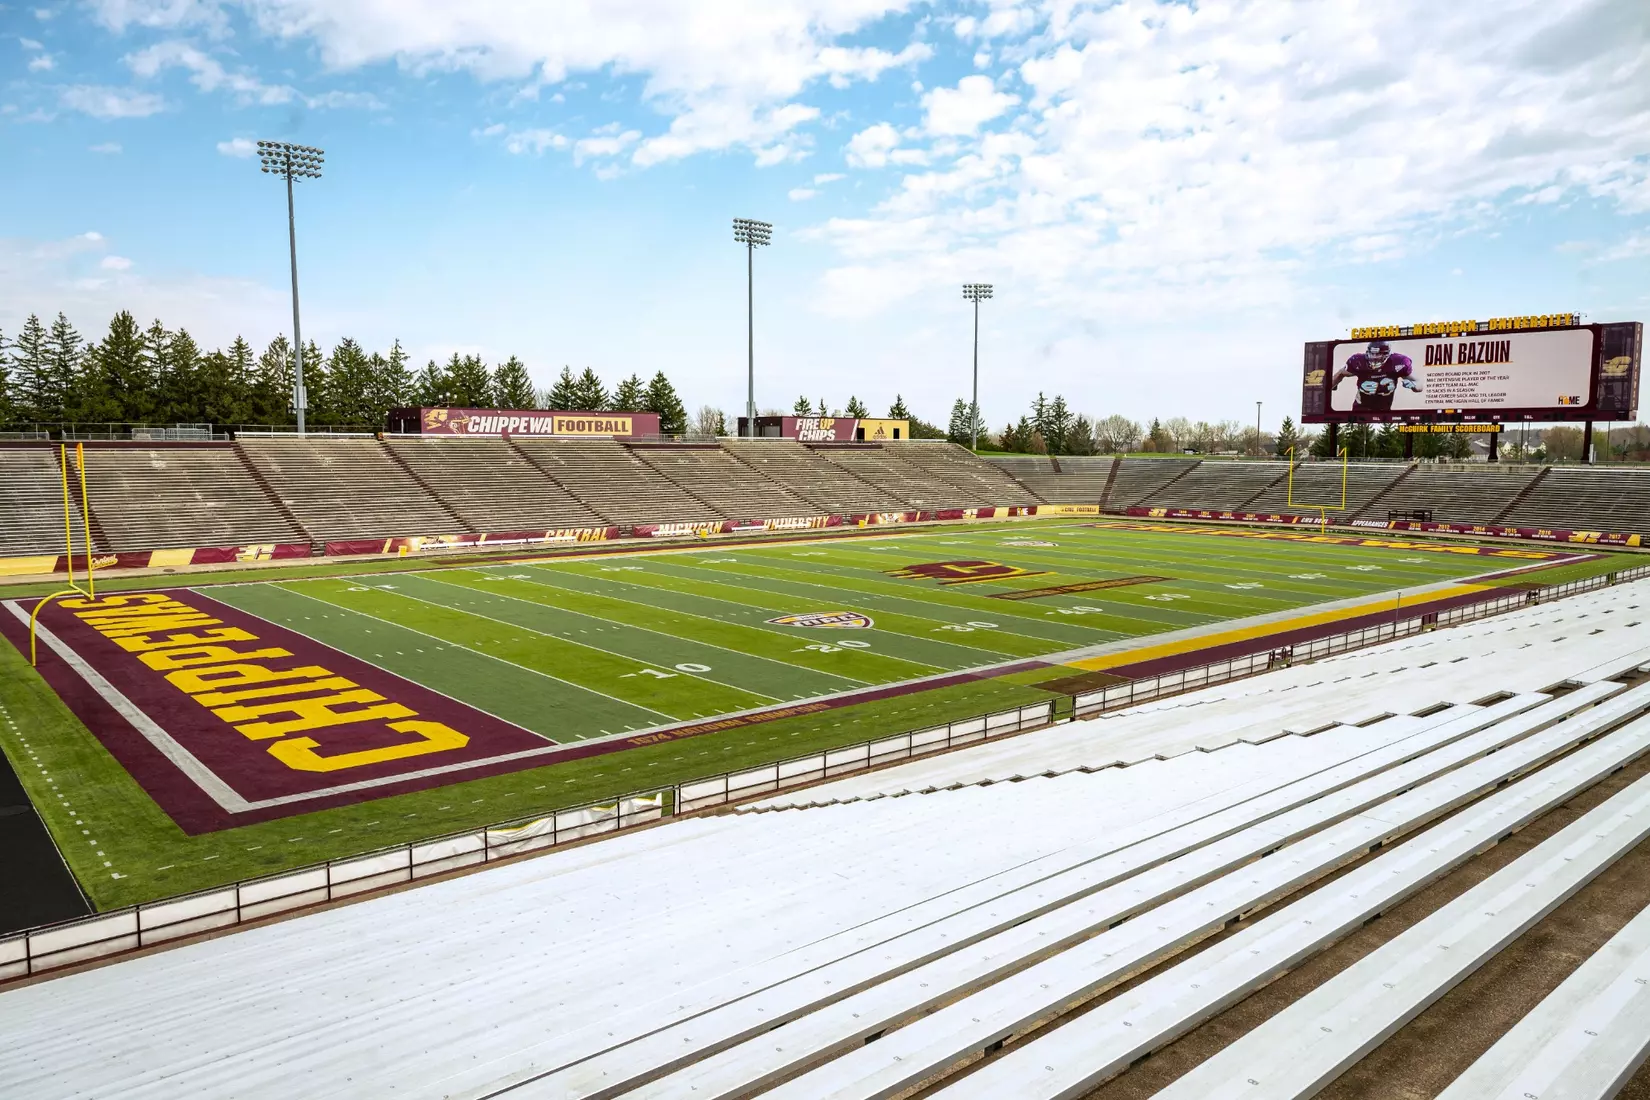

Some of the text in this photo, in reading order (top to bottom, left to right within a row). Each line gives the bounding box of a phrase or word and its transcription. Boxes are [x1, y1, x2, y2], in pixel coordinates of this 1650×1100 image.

[1351, 313, 1573, 340] CENTRAL MICHIGAN UNIVERSITY
[1425, 340, 1510, 365] DAN BAZUIN
[467, 415, 629, 433] CHIPPEWA FOOTBALL
[796, 418, 835, 430] FIRE UP
[1400, 424, 1500, 433] McGUIRK FAMILY SCOREBOARD
[799, 429, 836, 441] CHIPS
[658, 521, 723, 537] MICHIGAN
[764, 516, 830, 531] UNIVERSITY
[1352, 519, 1389, 528] APPEARANCES
[545, 527, 608, 542] CENTRAL
[803, 640, 871, 653] 20
[634, 663, 712, 679] 10
[57, 593, 471, 773] CHIPPEWAS
[670, 718, 749, 738] NATIONAL
